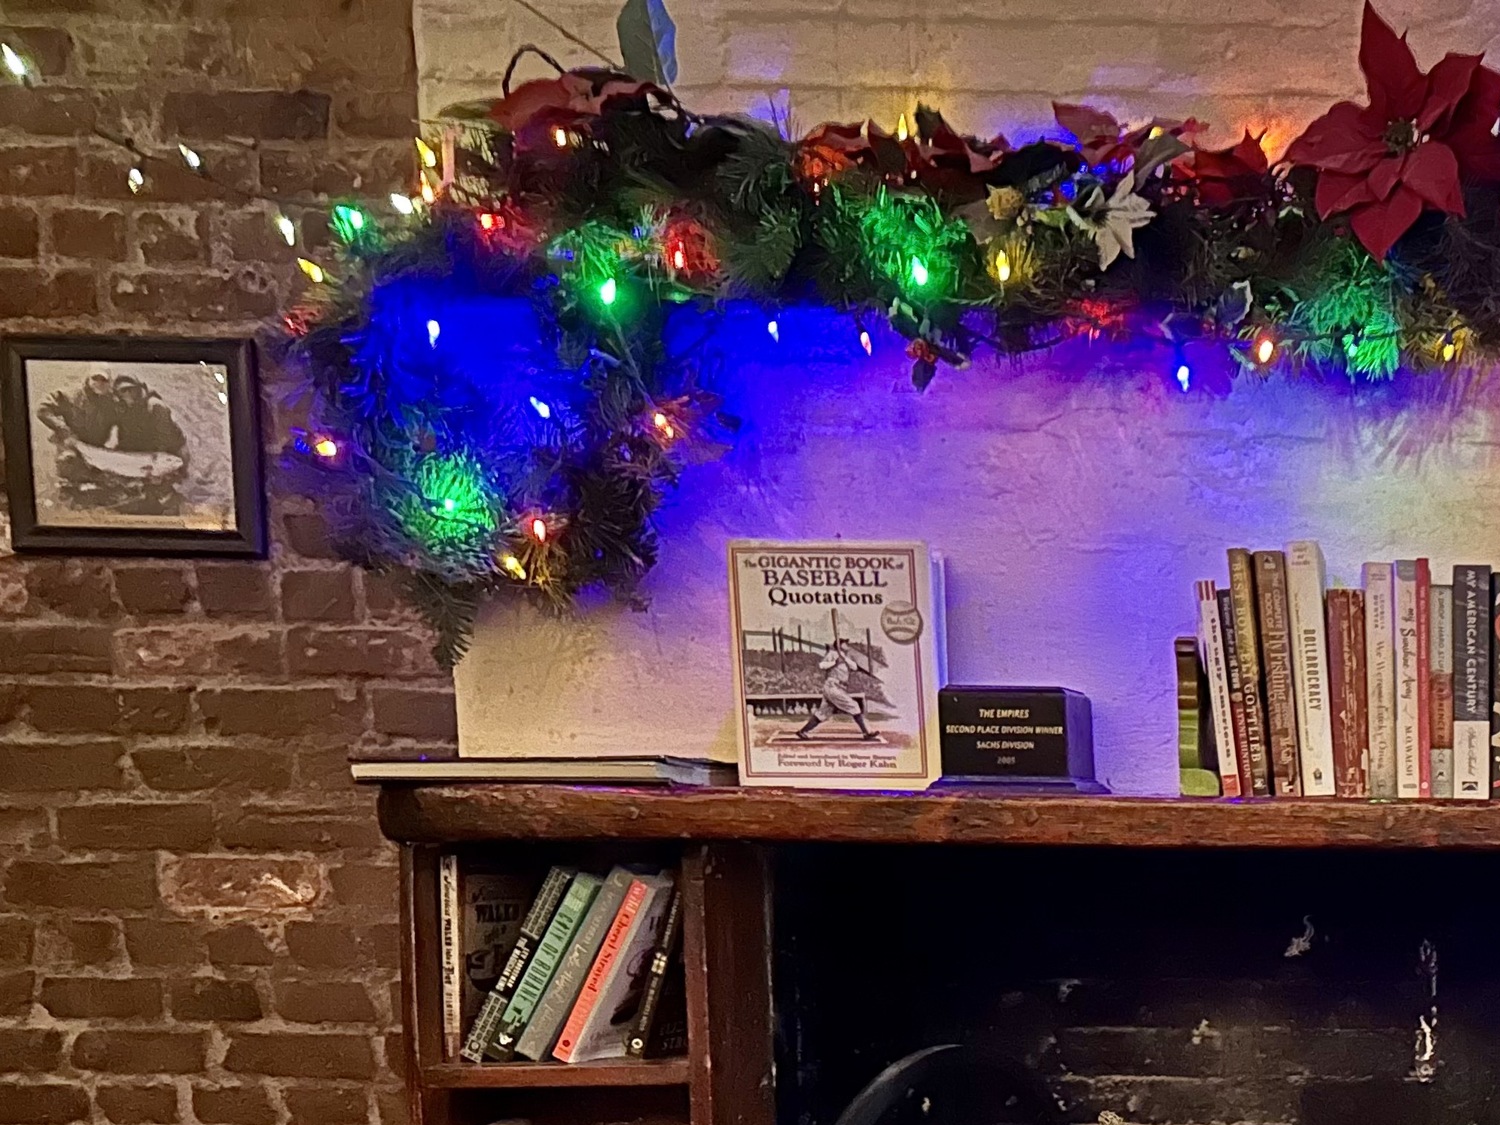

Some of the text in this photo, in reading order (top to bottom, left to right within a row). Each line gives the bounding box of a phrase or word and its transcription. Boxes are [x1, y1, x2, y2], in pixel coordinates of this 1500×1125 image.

[758, 556, 841, 569] GIGANTIC
[845, 557, 895, 570] BOOK
[762, 570, 888, 587] BASEBALL
[768, 587, 883, 606] Quotations
[1264, 592, 1273, 615] BOOK
[1272, 589, 1283, 628] COMPLETE
[1210, 618, 1218, 643] the
[1400, 628, 1416, 668] Sunshine
[1466, 570, 1476, 712] MY AMERICAN CENTURY
[1213, 647, 1222, 681] ugly
[1232, 562, 1261, 762] BEST BOY ELI GOTTLIEB
[1265, 630, 1291, 700] Fly Fishing
[1303, 628, 1321, 711] DOLLAROCRACY
[1400, 673, 1416, 699] Away
[946, 724, 1063, 734] SECOND PLACE DIVISION WINNER
[979, 709, 1030, 718] THE EMPIRES
[1217, 685, 1231, 757] american
[1002, 741, 1034, 749] DIVISION
[1236, 708, 1250, 777] LYNNE HINTON
[825, 760, 834, 768] by
[839, 760, 866, 768] Roger
[870, 760, 897, 768] Kahn
[606, 912, 630, 950] Cheryl
[494, 936, 527, 992] THE MAGICIAN KING
[539, 941, 559, 960] OF
[514, 958, 553, 1005] BOHANE
[586, 949, 614, 992] Strayed
